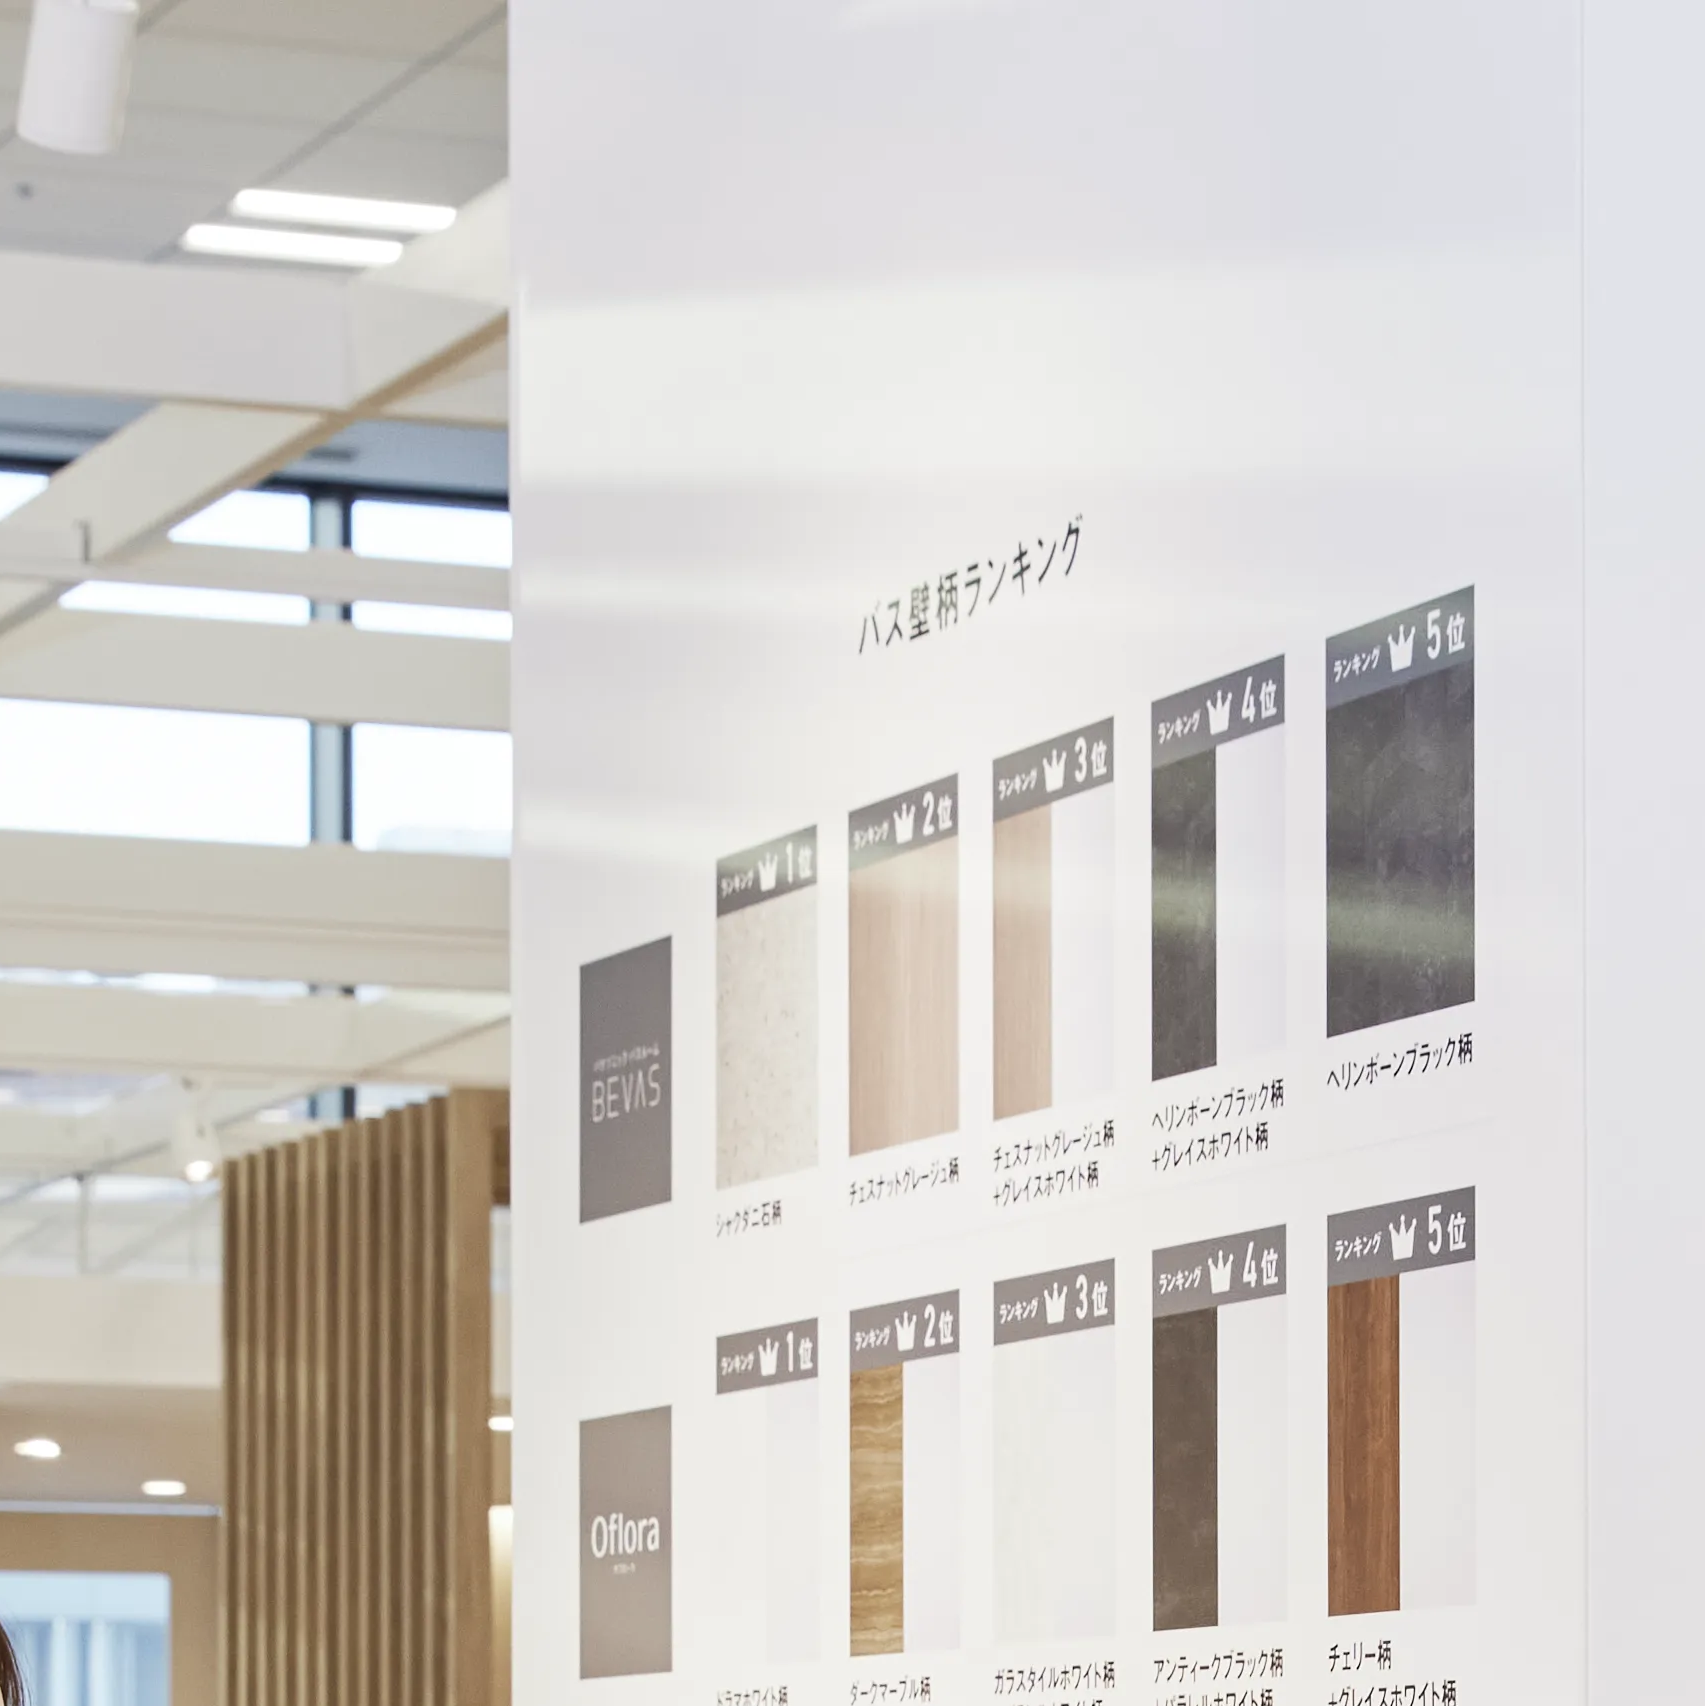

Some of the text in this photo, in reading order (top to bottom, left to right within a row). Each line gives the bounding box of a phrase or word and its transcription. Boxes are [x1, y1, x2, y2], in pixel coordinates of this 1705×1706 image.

[859, 513, 1083, 655] バス壁柄ランキング
[1333, 609, 1466, 682] ランキング 5位
[1157, 676, 1278, 744] ランキング 4位
[998, 737, 1108, 800] ランキング 3位
[852, 790, 953, 851] ランキング 2位
[785, 841, 814, 885] 1位
[1326, 1032, 1474, 1089] ヘリンボーンブラック柄
[1152, 1077, 1285, 1130] ヘリンボーンブラック柄
[993, 1119, 1115, 1172] チェスナットグレージュ柄
[1334, 1205, 1467, 1261] ランキング 5位
[1158, 1241, 1279, 1295] ランキング 4位
[999, 1274, 1108, 1324] ランキング 3位
[786, 1331, 813, 1372] 1位
[855, 1303, 954, 1349] ランキング 2位
[592, 1512, 660, 1559] Oflora
[994, 1660, 1115, 1696] ガラスタイルホワイト柄
[1153, 1648, 1284, 1683] アンティークブラック柄
[1328, 1640, 1392, 1672] チェリー柄
[850, 1676, 931, 1706] ダークマーブル柄
